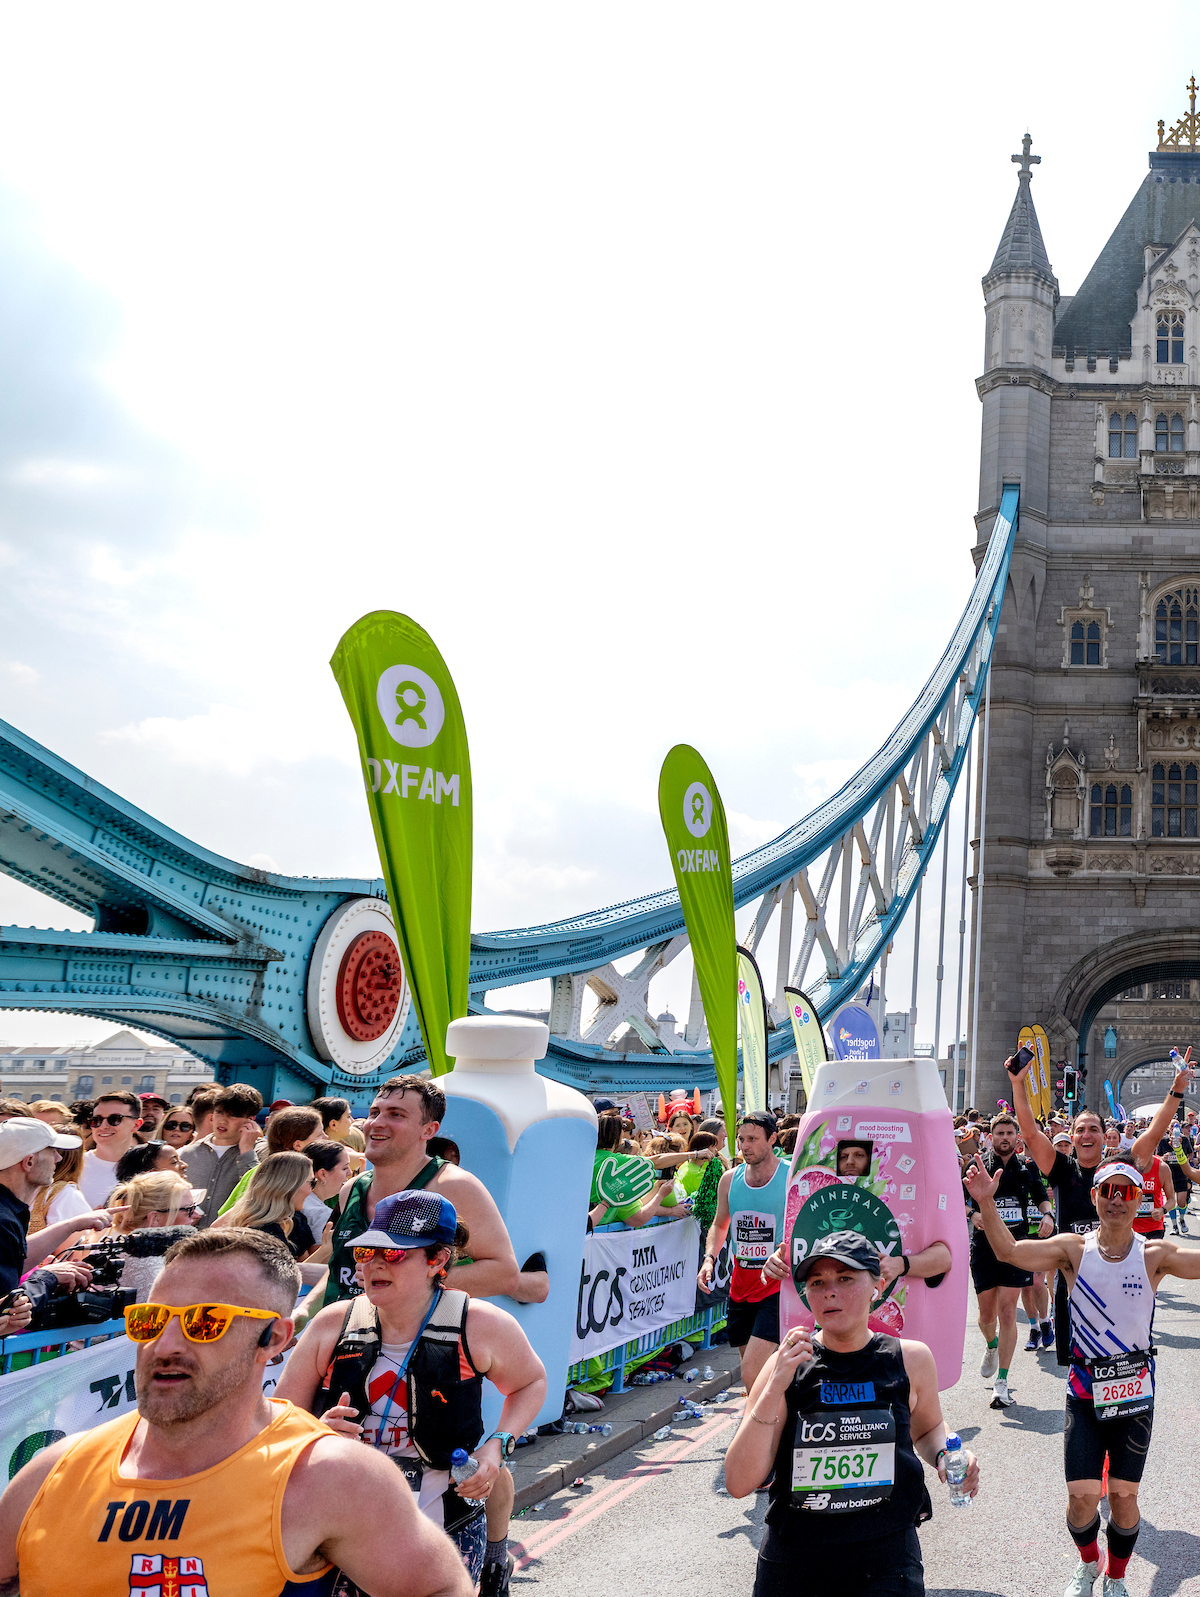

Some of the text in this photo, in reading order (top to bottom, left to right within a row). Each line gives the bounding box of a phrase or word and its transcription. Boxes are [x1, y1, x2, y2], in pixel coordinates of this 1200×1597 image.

[366, 757, 460, 807] OXFAM
[677, 849, 720, 873] OXFAM
[867, 1132, 896, 1140] fragrance
[877, 1125, 904, 1133] boosting
[1142, 1181, 1155, 1191] KER
[809, 1190, 881, 1217] MINERAL
[737, 1216, 766, 1228] BRAIN
[632, 1245, 658, 1269] TATA
[741, 1245, 767, 1257] 24106
[630, 1260, 687, 1295] CONSULTANCY
[577, 1258, 627, 1340] tcs
[629, 1292, 666, 1321] SERVICES
[1094, 1366, 1116, 1379] tcs
[1102, 1380, 1143, 1401] 26282
[1129, 1405, 1149, 1414] balance
[840, 1416, 861, 1424] TATA
[801, 1420, 836, 1442] tcs
[839, 1422, 889, 1433] CONSULTANCY
[839, 1432, 872, 1441] SERVICES
[810, 1453, 879, 1481] 75637
[830, 1501, 848, 1510] new
[849, 1497, 883, 1508] balance
[97, 1499, 191, 1543] TOM
[141, 1558, 197, 1572] R N
